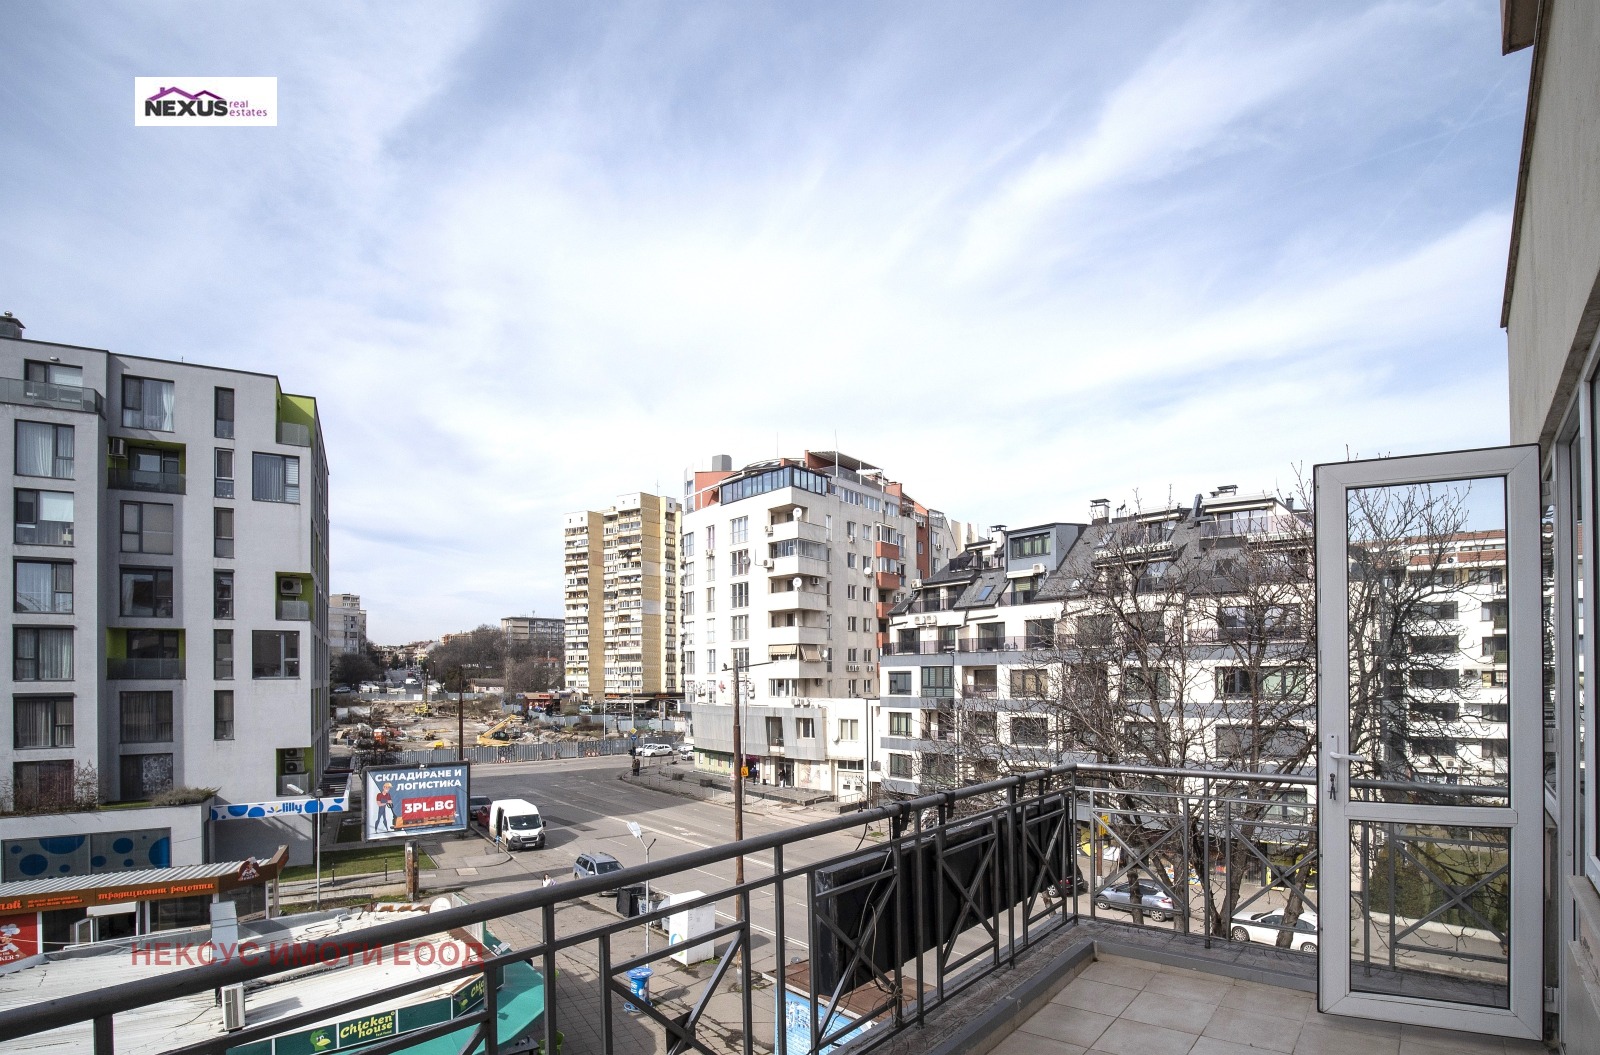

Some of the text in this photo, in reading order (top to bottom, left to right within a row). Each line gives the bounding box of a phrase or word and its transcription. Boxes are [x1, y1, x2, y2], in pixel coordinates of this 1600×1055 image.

[375, 768, 462, 782] СКЛАДИРАНЕ И
[396, 779, 462, 791] ЛОГИСТИКА
[282, 802, 303, 814] lilly
[404, 800, 454, 814] 3PL.BG
[170, 883, 215, 895] рецепти
[340, 1014, 393, 1039] Chicken
[358, 1021, 393, 1038] house
